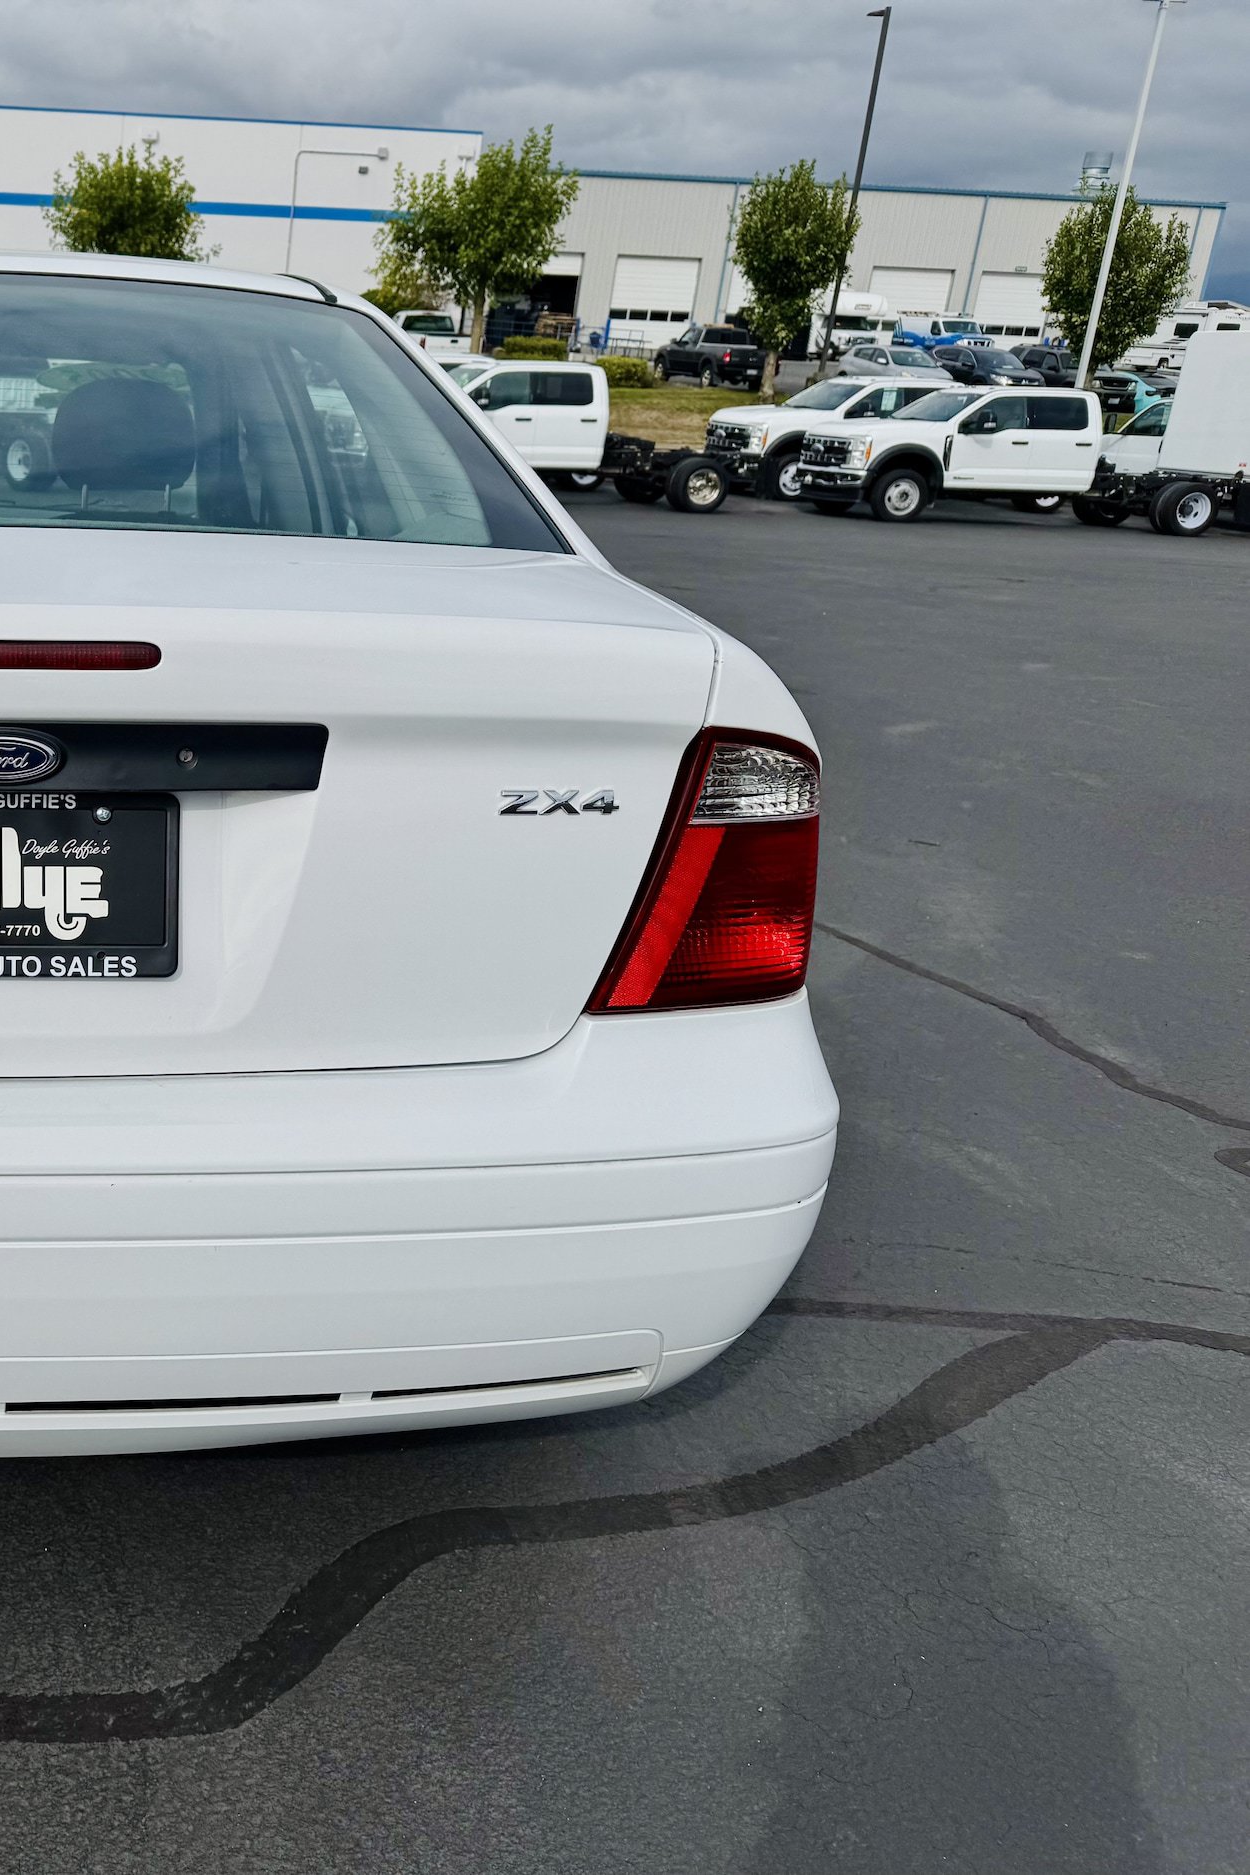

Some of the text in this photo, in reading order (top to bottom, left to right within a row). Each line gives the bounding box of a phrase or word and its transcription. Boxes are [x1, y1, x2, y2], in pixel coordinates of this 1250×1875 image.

[498, 789, 620, 815] ZX4
[22, 838, 111, 860] Doyle Guffie's
[49, 955, 138, 978] SALES
